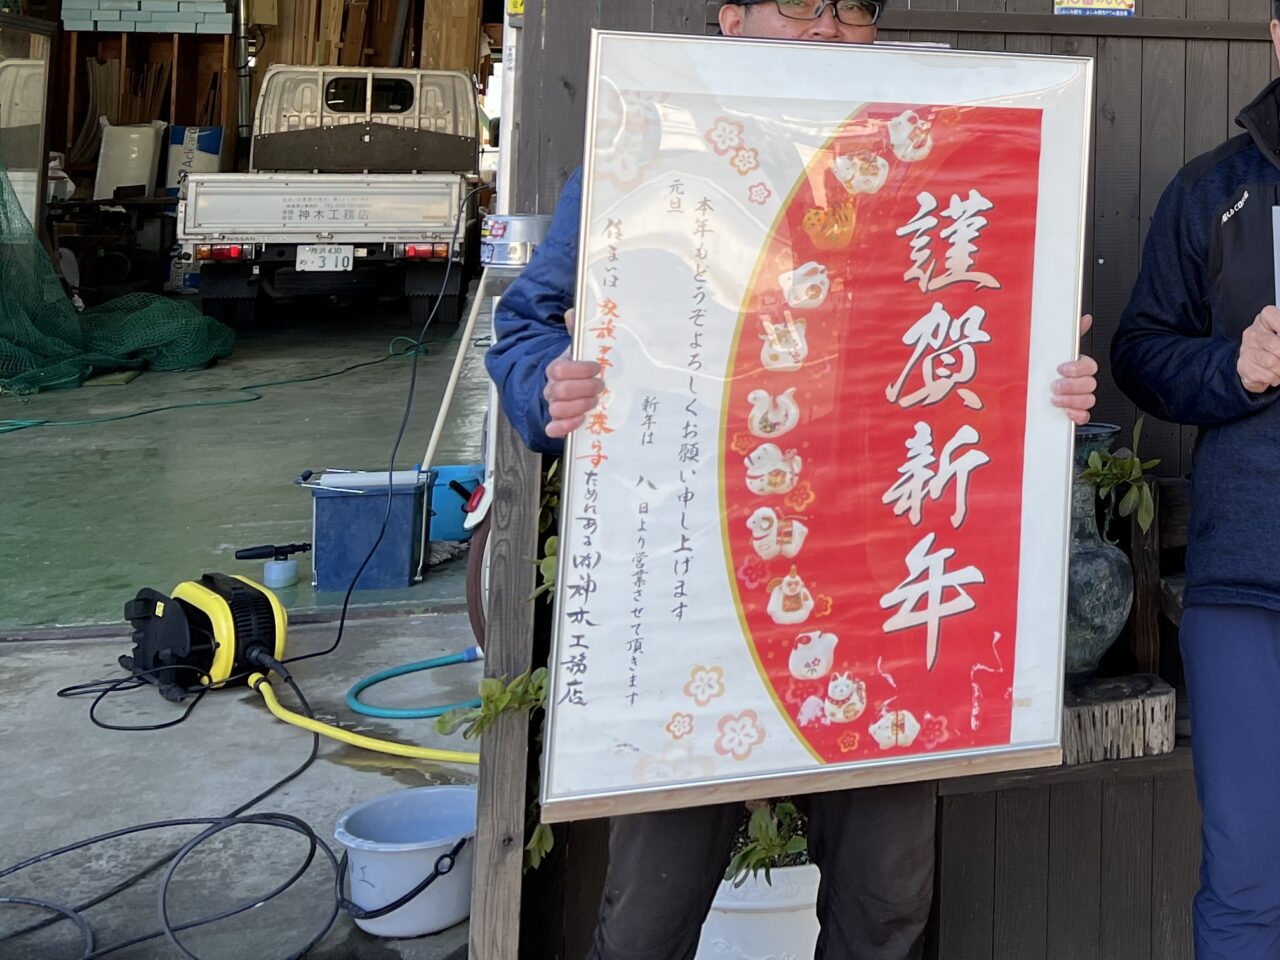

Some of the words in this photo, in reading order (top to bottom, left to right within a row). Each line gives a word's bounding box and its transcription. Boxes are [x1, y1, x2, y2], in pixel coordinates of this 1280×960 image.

[666, 179, 684, 213] 元旦
[671, 196, 715, 622] 本年もどうぞよろしくお願い申し上げます
[879, 189, 1001, 672] 謹賀新年
